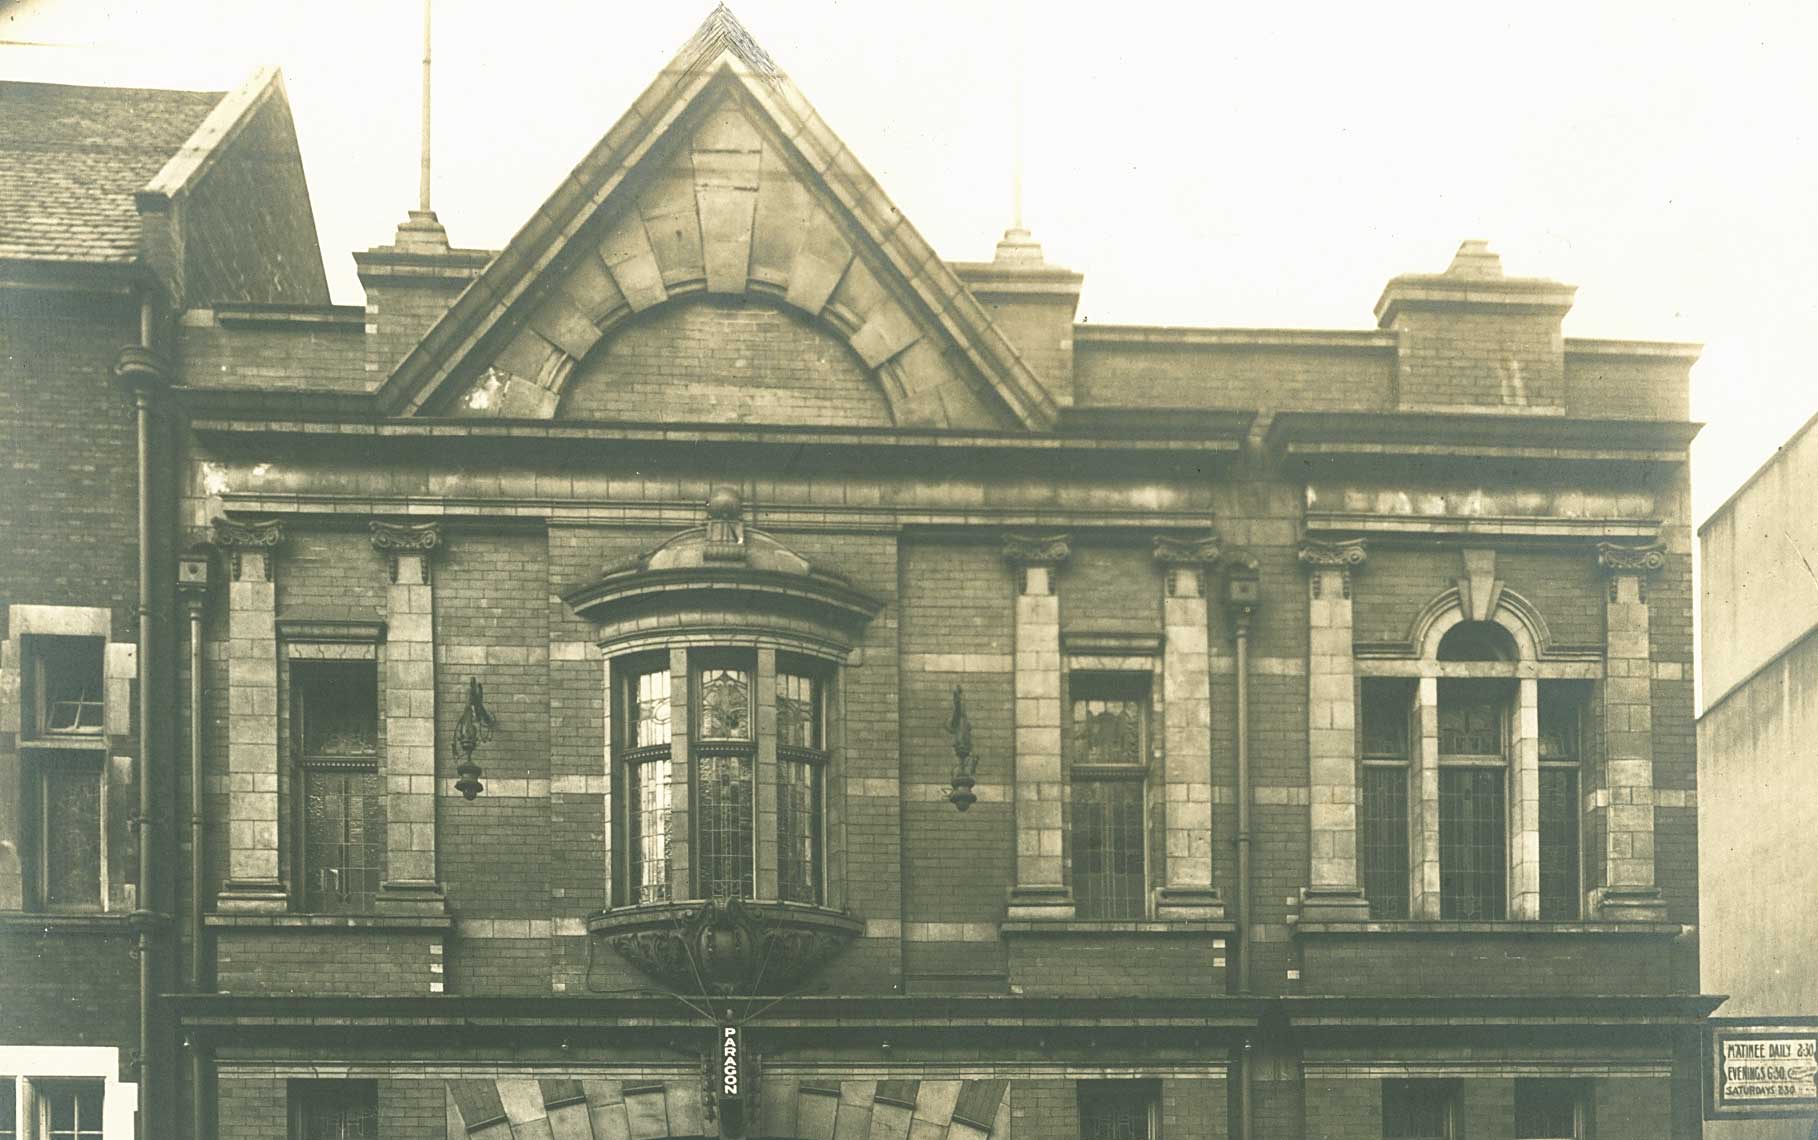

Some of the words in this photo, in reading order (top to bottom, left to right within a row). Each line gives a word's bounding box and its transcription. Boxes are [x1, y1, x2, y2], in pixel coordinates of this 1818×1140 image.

[1727, 1044, 1766, 1059] MATINEE
[1769, 1044, 1791, 1058] DAILY
[724, 1027, 737, 1093] PARAGON
[1727, 1066, 1766, 1081] EVENINGS
[1725, 1086, 1775, 1096] SATURDAYS
